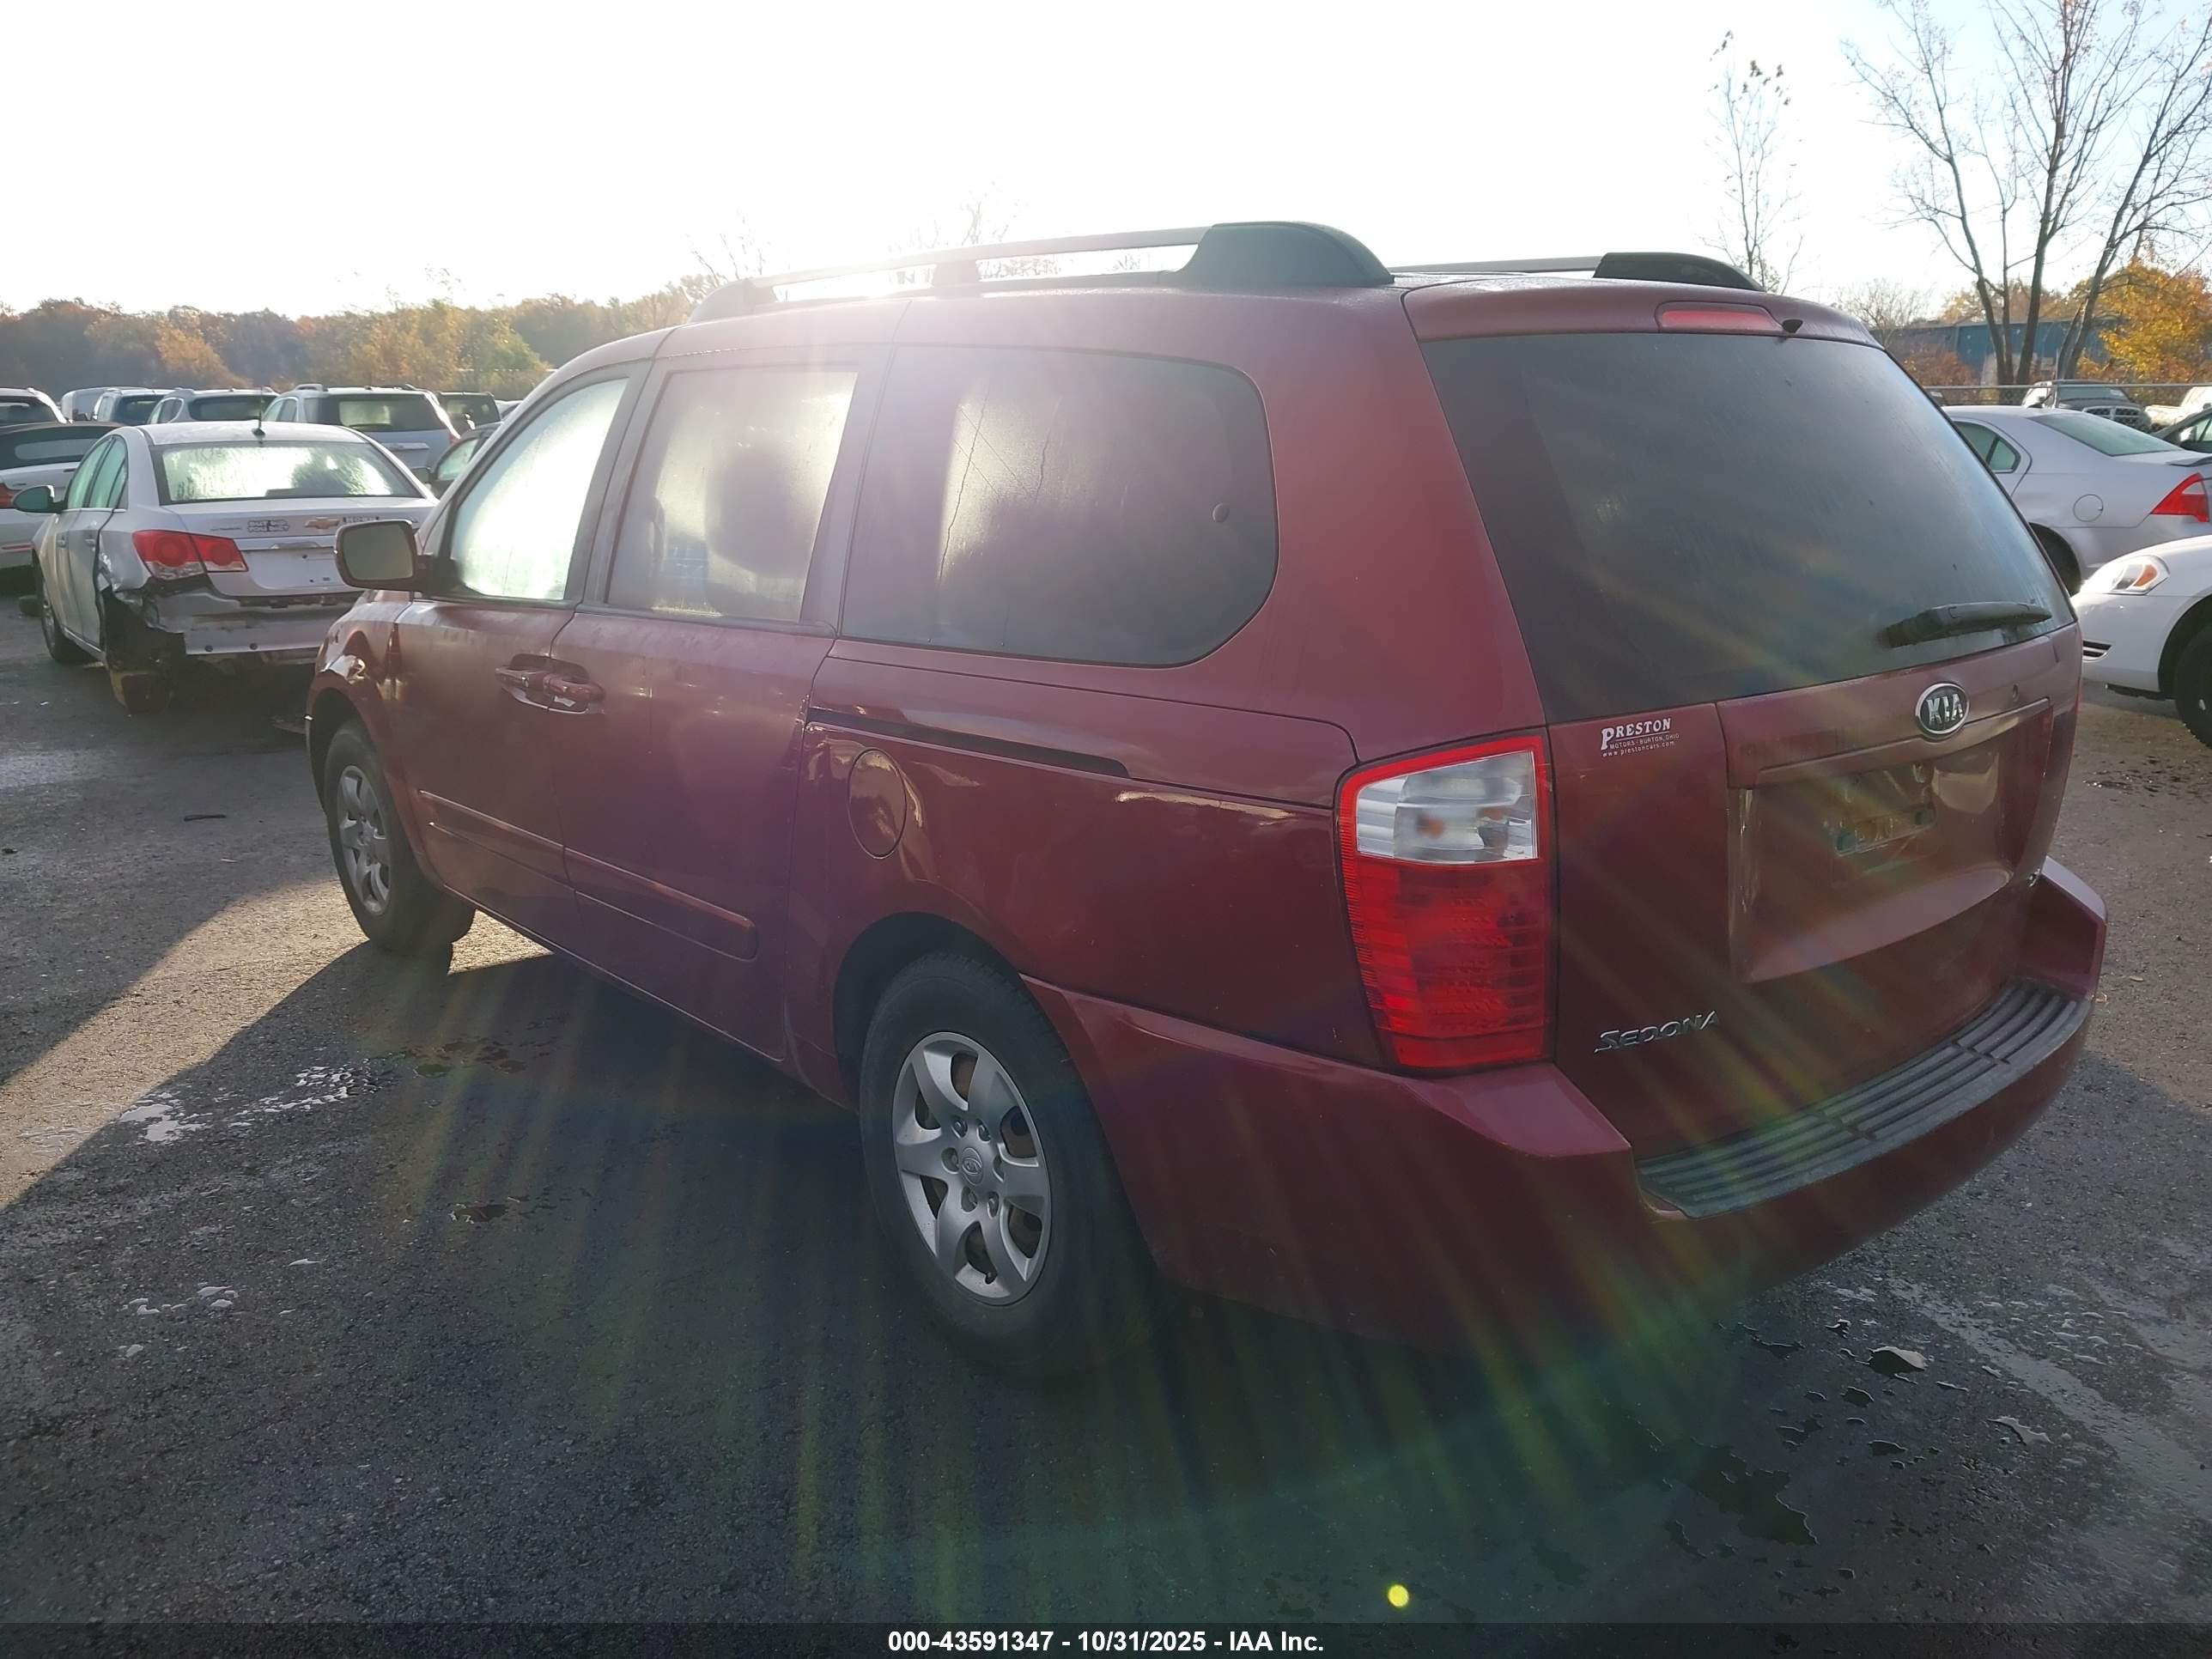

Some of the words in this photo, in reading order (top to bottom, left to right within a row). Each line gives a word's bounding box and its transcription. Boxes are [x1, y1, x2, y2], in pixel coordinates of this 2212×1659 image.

[1926, 693, 1963, 725] KIA
[1601, 718, 1671, 750] PRESTON
[1609, 740, 1635, 750] MOTORS
[1595, 1011, 1717, 1053] SEDONA
